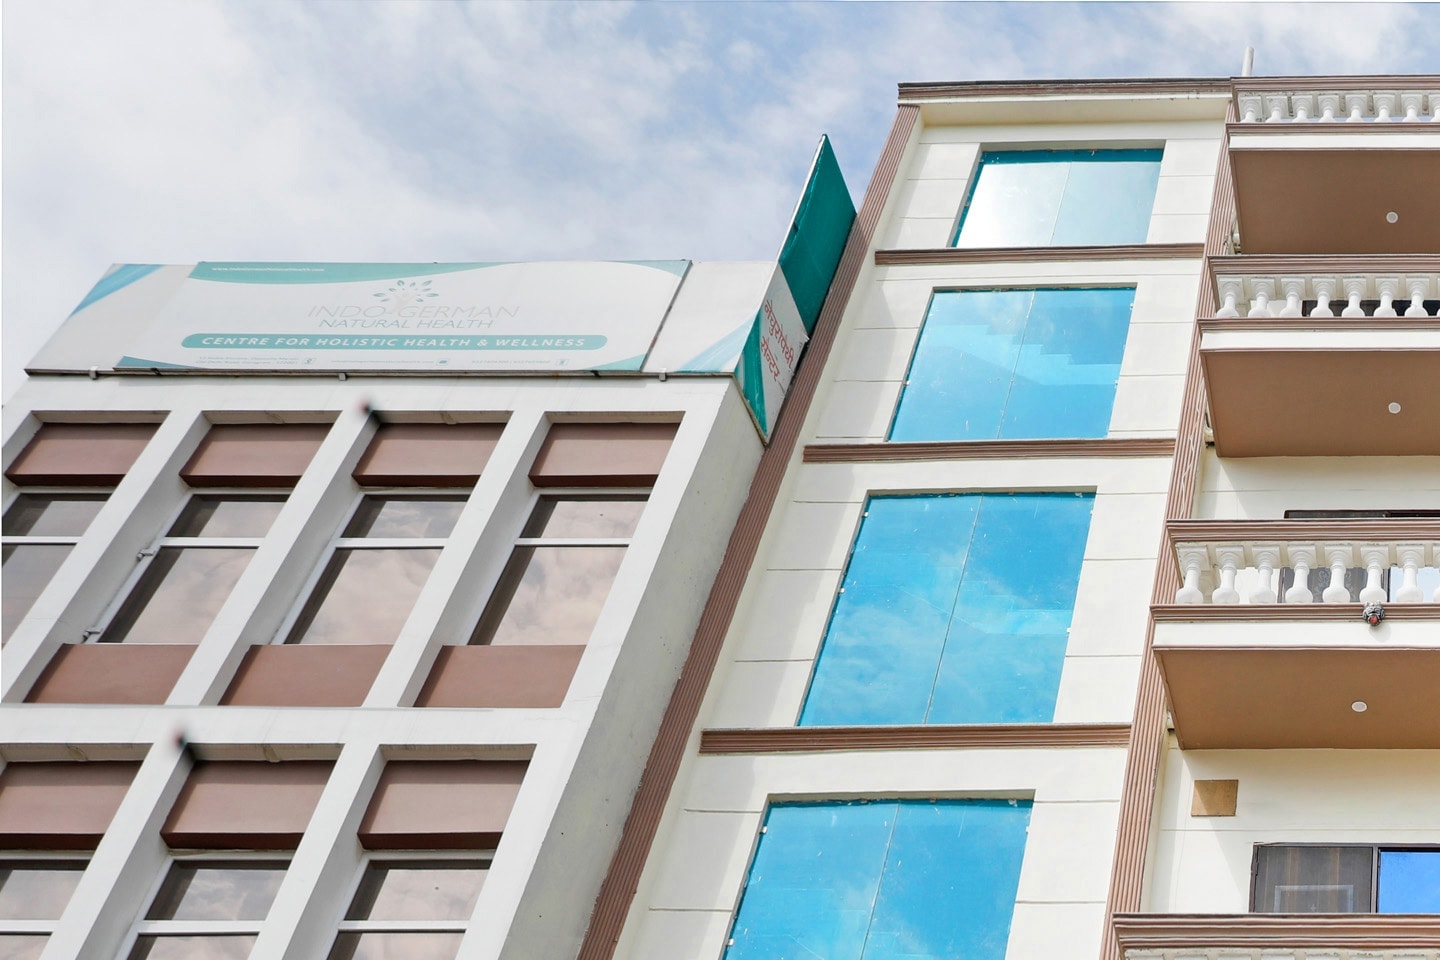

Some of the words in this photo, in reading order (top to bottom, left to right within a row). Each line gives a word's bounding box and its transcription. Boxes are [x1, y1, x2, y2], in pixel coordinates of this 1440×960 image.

[318, 318, 410, 329] NATURAL
[416, 319, 494, 329] HEALTH
[201, 337, 270, 346] CENTRE
[274, 337, 310, 346] FOR
[315, 338, 399, 347] HOLISTIC
[403, 338, 471, 347] HEALTH
[476, 338, 489, 347] &
[495, 338, 586, 347] WELLNESS
